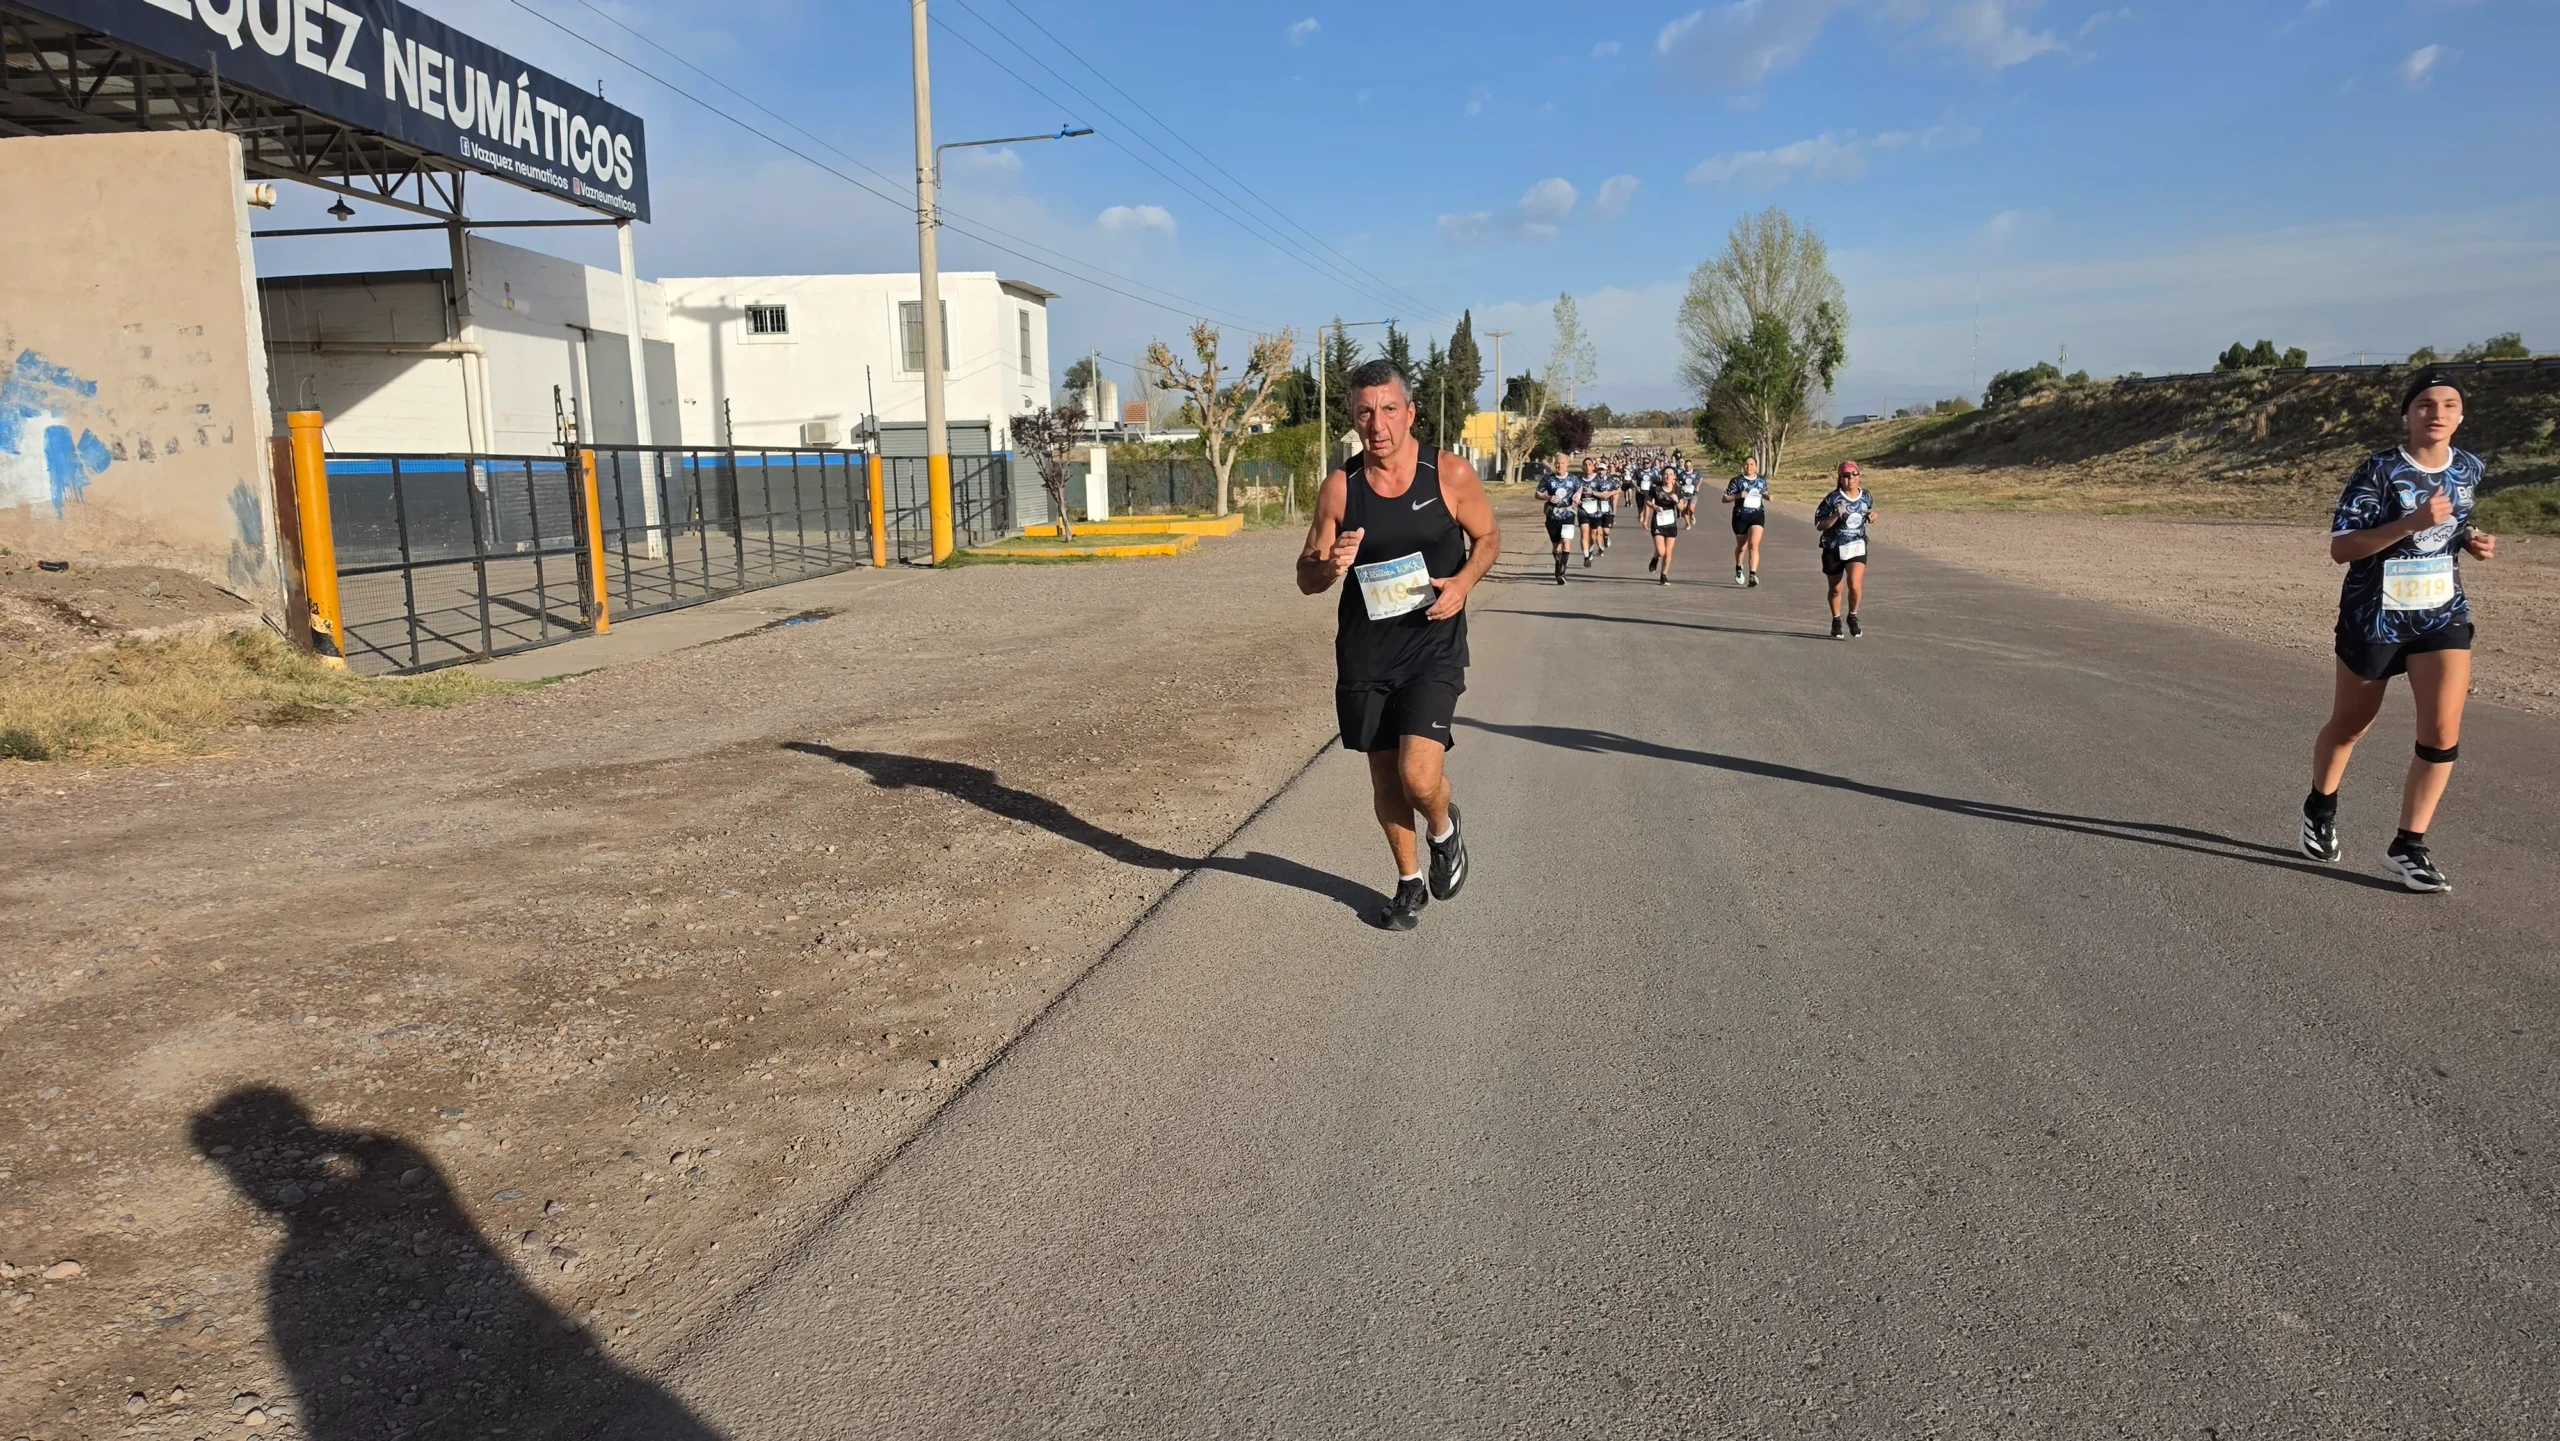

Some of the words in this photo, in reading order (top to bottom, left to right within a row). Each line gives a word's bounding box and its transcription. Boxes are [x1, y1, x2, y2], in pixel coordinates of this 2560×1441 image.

[383, 27, 634, 190] NEUMÁTICOS
[471, 141, 514, 173] Vazquez
[515, 160, 569, 191] neumaticos
[579, 180, 637, 214] Vazneumaticos
[2392, 577, 2446, 598] 1219
